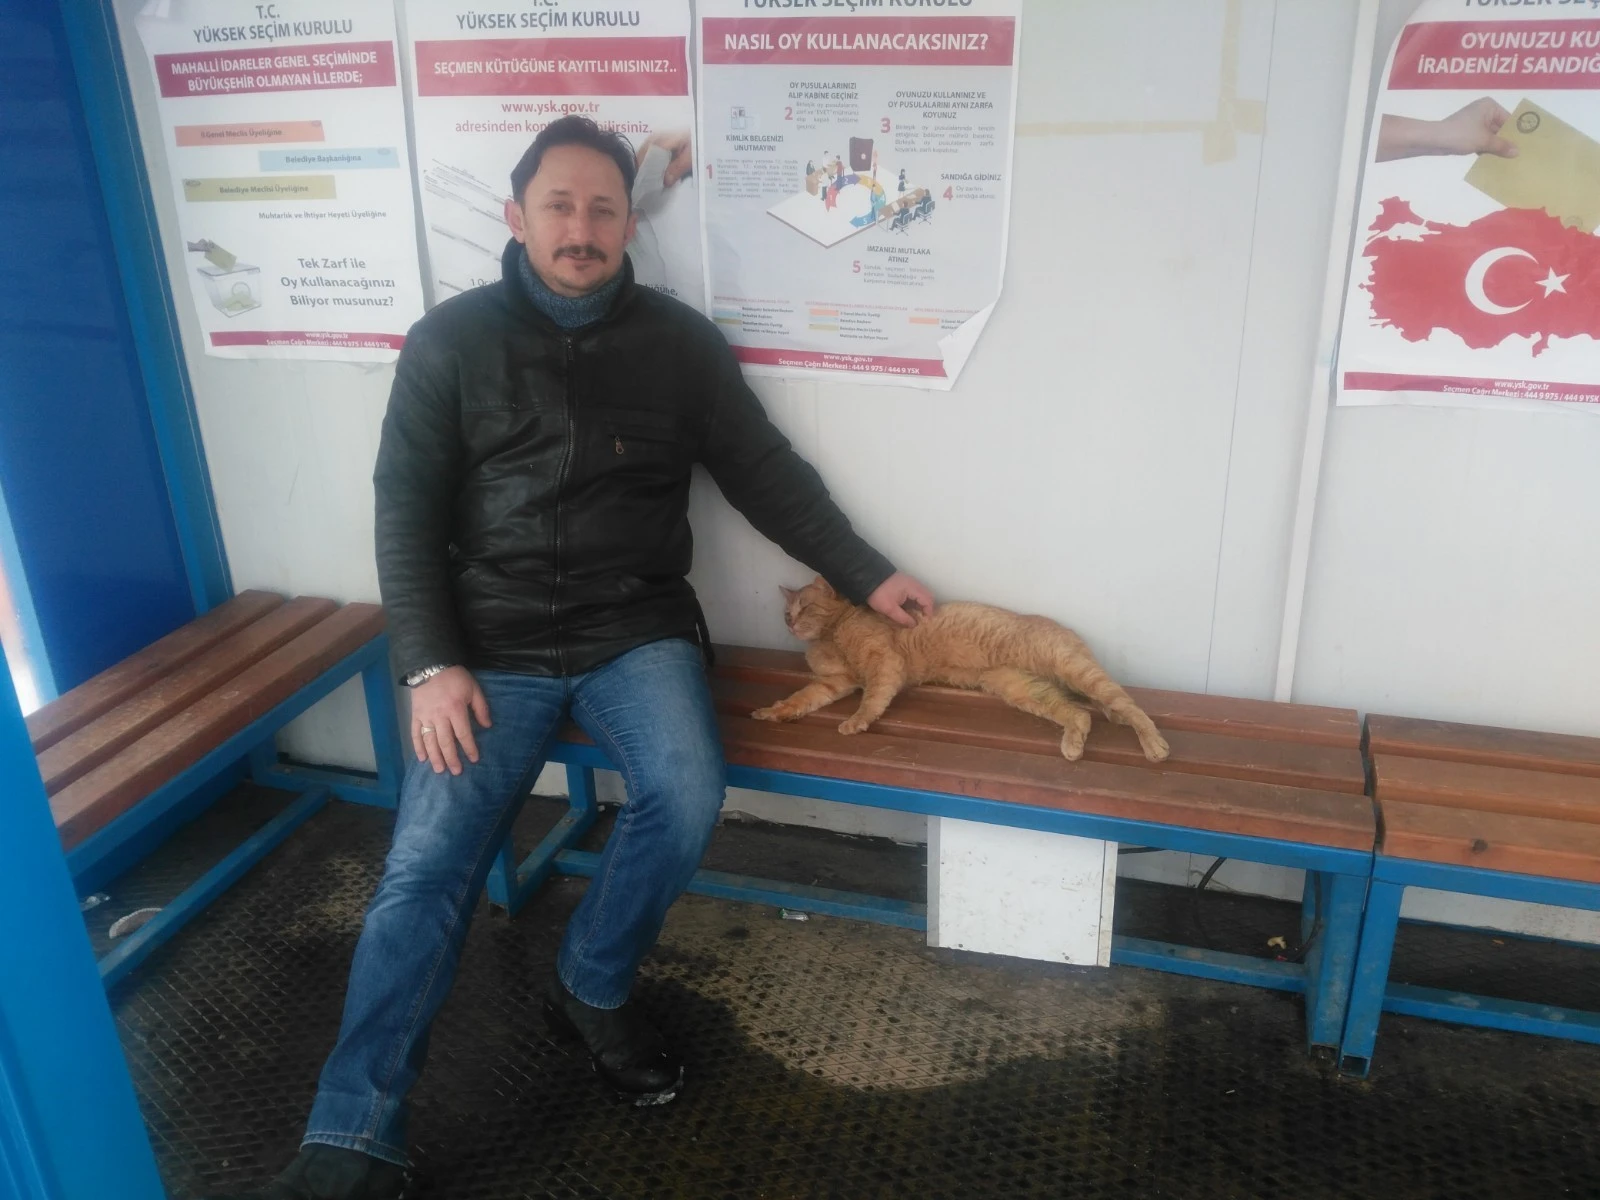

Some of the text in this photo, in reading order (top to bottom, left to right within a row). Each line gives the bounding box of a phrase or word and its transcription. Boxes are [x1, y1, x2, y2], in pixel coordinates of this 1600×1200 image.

[256, 5, 280, 20] T.C.
[456, 9, 640, 32] YÜKSEK SEÇİM KURULU
[193, 19, 352, 44] YÜKSEK SEÇİM KURULU
[724, 33, 989, 51] NASIL OY KULLANACAKSINIZ?
[1461, 31, 1600, 50] OYUNUZU KU
[171, 51, 377, 75] MAHALLİ İDARELER GENEL SEÇİMİNDE
[434, 58, 677, 77] SEÇMEN KÜTÜĞÜNE KAYITLI MISINIZ?..
[1417, 54, 1518, 74] İRADENİZİ
[187, 71, 363, 92] BÜYÜKŞEHİR OLMAYAN İLLERDE;
[800, 82, 857, 90] PUSULALARINIZI
[804, 91, 830, 100] KABİNE
[831, 92, 859, 101] GEÇİNİZ
[896, 91, 932, 99] OYUNUZU
[933, 91, 976, 99] KULLANINIZ
[501, 101, 600, 116] www.ysk.gov.tr
[888, 101, 898, 109] OY
[899, 101, 951, 109] PUSULALARINI
[784, 106, 793, 121] 2
[922, 111, 957, 119] KOYUNUZ
[455, 120, 521, 133] adresinden
[880, 117, 891, 134] 3
[206, 131, 224, 139] Genel
[226, 130, 248, 138] Meclis
[249, 129, 282, 138] Üyeliğine
[750, 135, 784, 143] BELGENİZİ
[285, 153, 362, 164] Belediye Başkanlığına
[706, 164, 713, 179] 1
[940, 172, 1002, 181] SANDIĞA GİDİNİZ
[219, 186, 249, 194] Belediye
[942, 185, 954, 201] 4
[259, 212, 292, 220] Muhtarlık
[328, 210, 350, 220] Heyeti
[351, 209, 386, 219] Üyeliğine
[897, 247, 931, 255] MUTLAKA
[298, 257, 366, 269] Tek Zarf ile
[887, 255, 909, 264] ATINIZ
[852, 259, 861, 274] 5
[280, 276, 395, 290] Oy Kullanacağınızı
[290, 295, 394, 308] Biliyor musunuz?
[823, 353, 873, 363] www.ysk.gov.tr
[778, 358, 803, 367] Seçmen
[804, 360, 821, 368] Çağrı
[822, 361, 848, 370] Merkezi
[852, 363, 864, 371] 444
[870, 364, 883, 372] 975
[1494, 380, 1550, 390] www.ysk.gov.tr
[1443, 384, 1471, 394] Seçmen
[1471, 386, 1491, 395] Çağrı
[1491, 388, 1520, 398] Merkezi
[1524, 391, 1538, 399] 444
[1539, 392, 1544, 400] 9
[1545, 392, 1559, 400] 975
[1563, 393, 1578, 401] 444
[1578, 394, 1584, 402] 9
[1585, 394, 1600, 402] YSK
